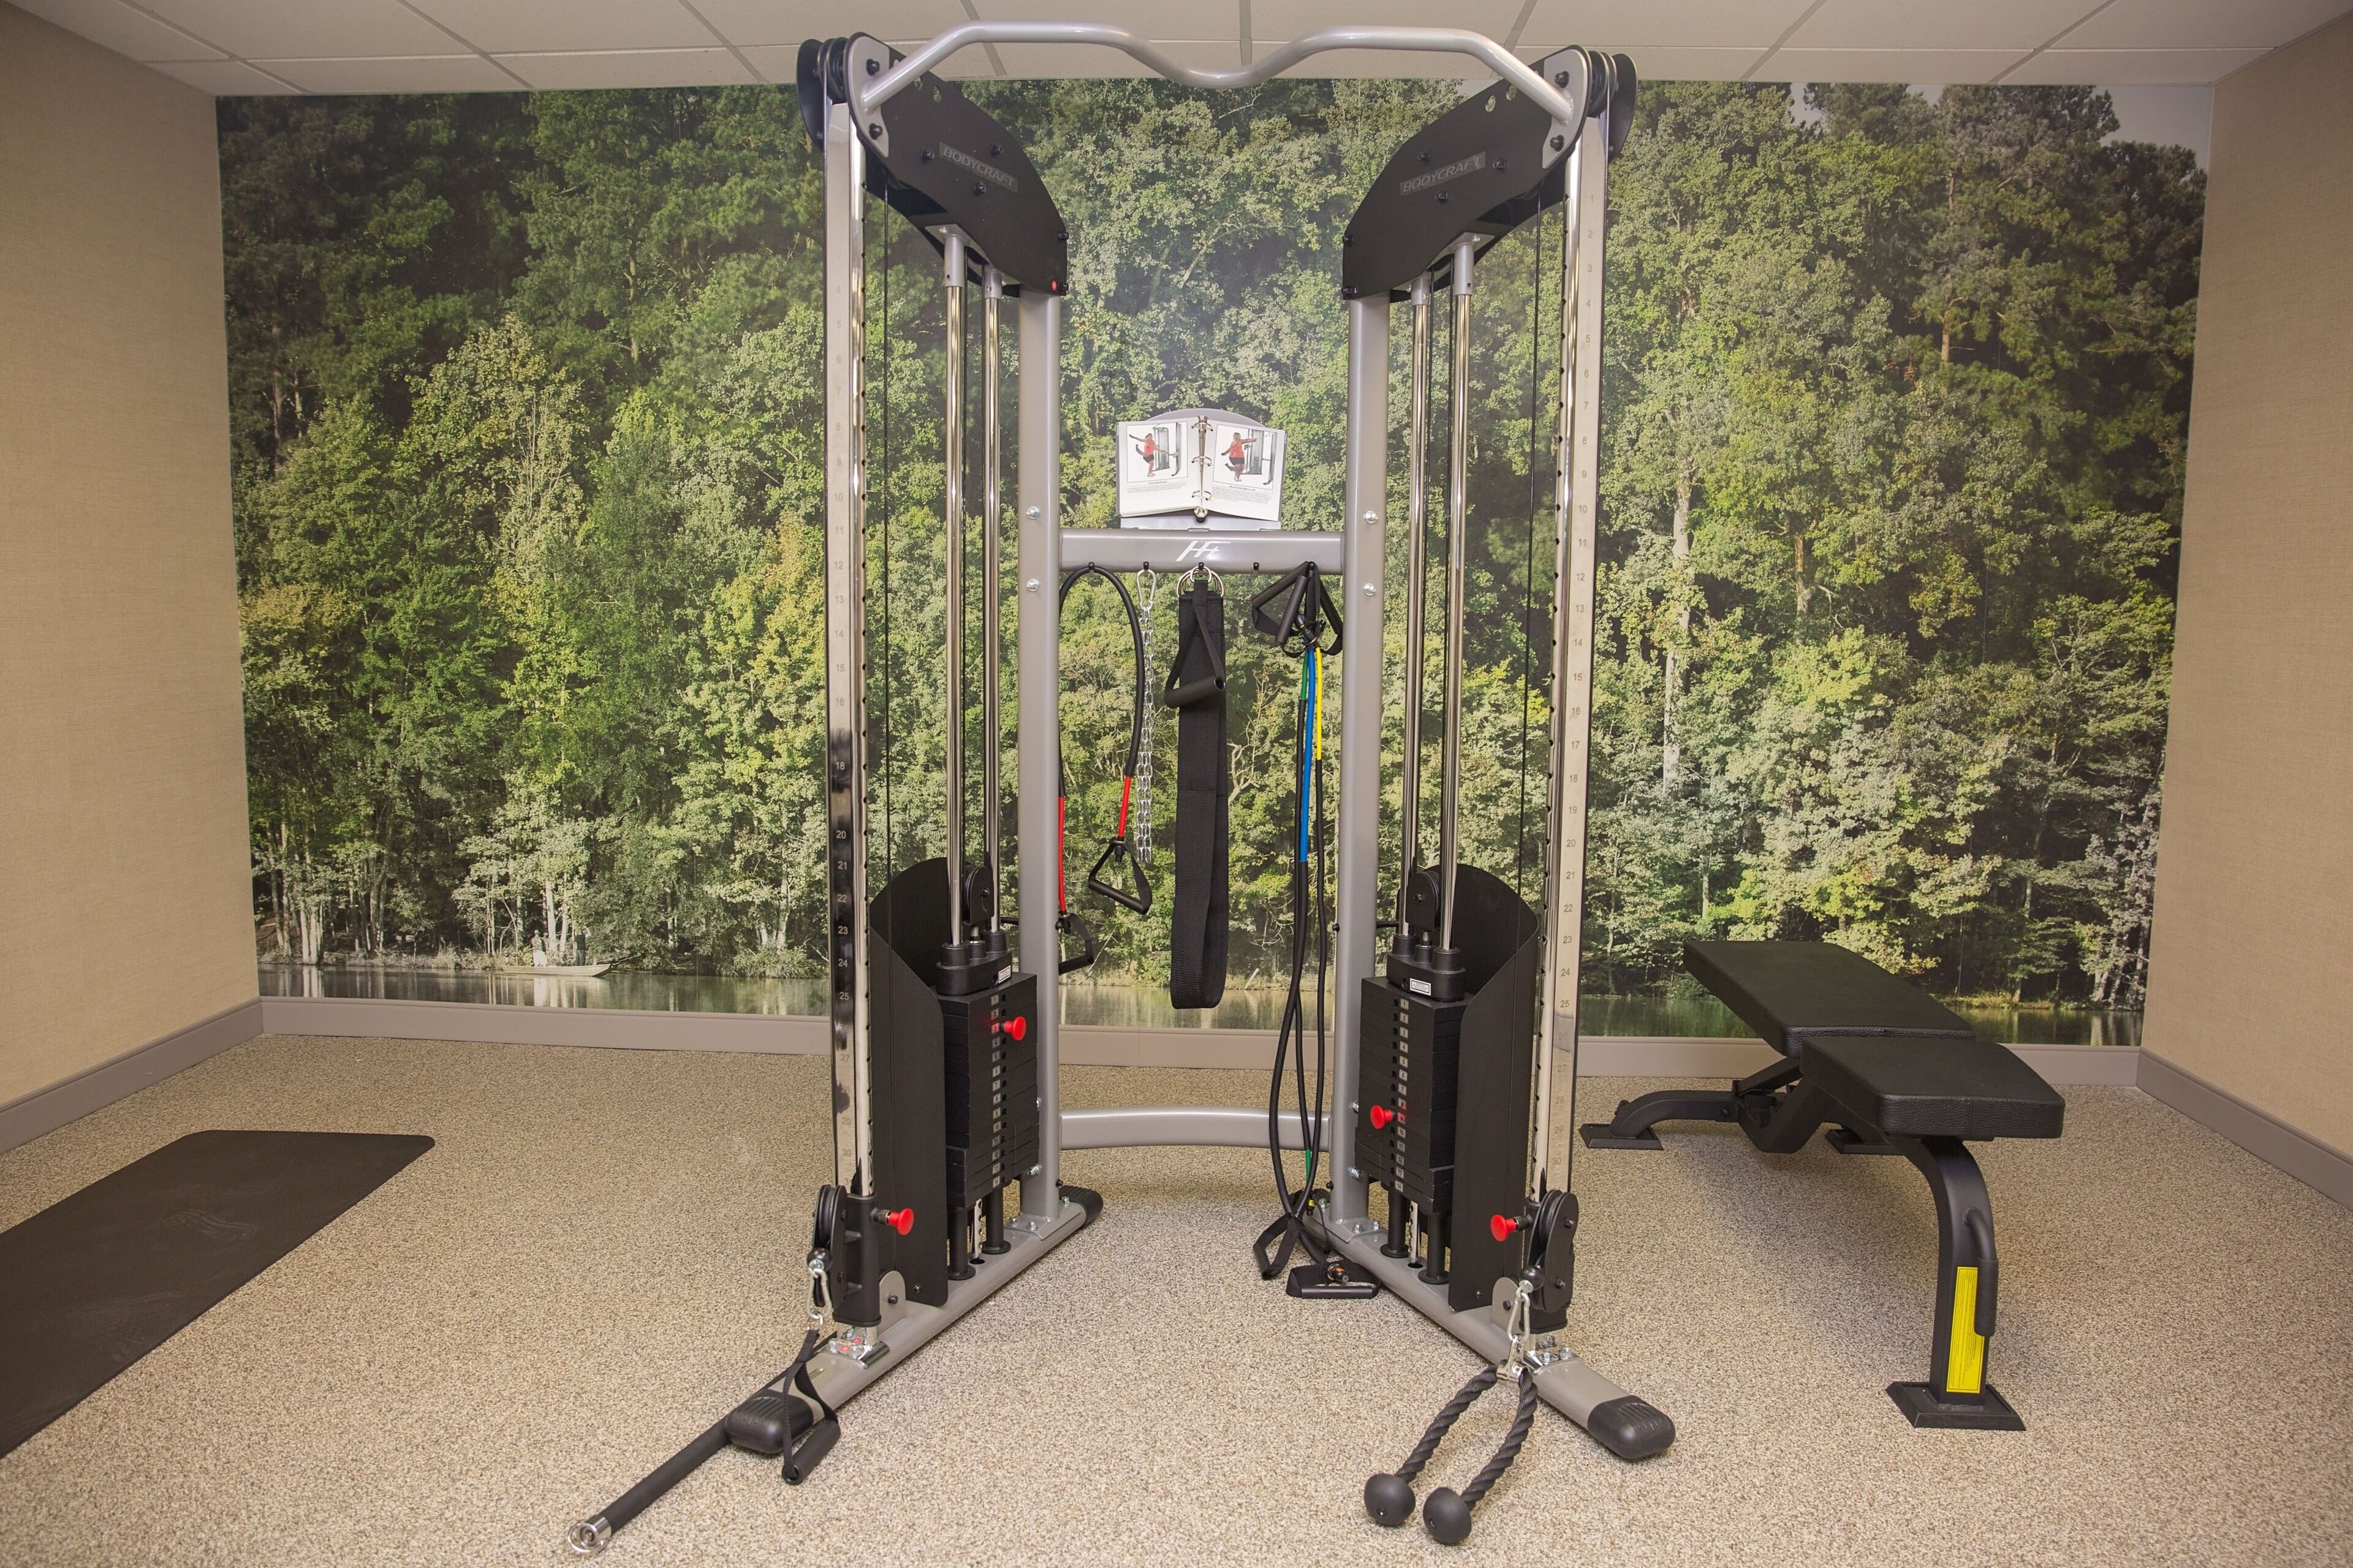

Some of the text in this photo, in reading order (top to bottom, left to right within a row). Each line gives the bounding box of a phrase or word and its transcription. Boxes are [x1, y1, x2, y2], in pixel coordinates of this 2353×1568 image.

[943, 147, 1015, 186] BODYCRAFT
[1403, 156, 1482, 192] BODYCRAFT
[1588, 229, 1593, 239] 2
[1587, 263, 1593, 273] 3
[835, 285, 841, 294] 4
[1586, 299, 1591, 308] 4
[836, 319, 841, 328] 5
[1585, 334, 1591, 343] 5
[836, 354, 841, 363] 6
[1584, 369, 1589, 378] 6
[836, 387, 841, 396] 7
[1584, 401, 1588, 411] 7
[835, 422, 841, 431] 8
[1582, 436, 1588, 445] 8
[833, 493, 843, 501] 10
[1578, 505, 1588, 513] 10
[835, 526, 843, 534] 11
[1578, 538, 1586, 547] 11
[833, 561, 843, 570] 12
[1576, 572, 1585, 581] 12
[835, 595, 844, 604] 13
[1575, 604, 1585, 613] 13
[835, 630, 843, 638] 14
[1574, 638, 1583, 647] 14
[835, 664, 845, 672] 15
[1571, 706, 1581, 716] 16
[1571, 741, 1580, 749] 17
[836, 761, 845, 770] 18
[1569, 775, 1578, 783] 18
[836, 830, 846, 839] 20
[1566, 839, 1576, 847] 20
[838, 861, 847, 870] 21
[1566, 871, 1575, 879] 21
[837, 893, 847, 903] 22
[1563, 904, 1573, 912] 22
[838, 926, 848, 935] 23
[1563, 935, 1572, 944] 23
[838, 958, 848, 968] 24
[1561, 968, 1570, 977] 24
[839, 991, 849, 1001] 25
[1560, 999, 1569, 1008] 25
[840, 1053, 850, 1062] 27
[1557, 1064, 1567, 1073] 27
[842, 1148, 852, 1157] 30
[1552, 1156, 1561, 1165] 30
